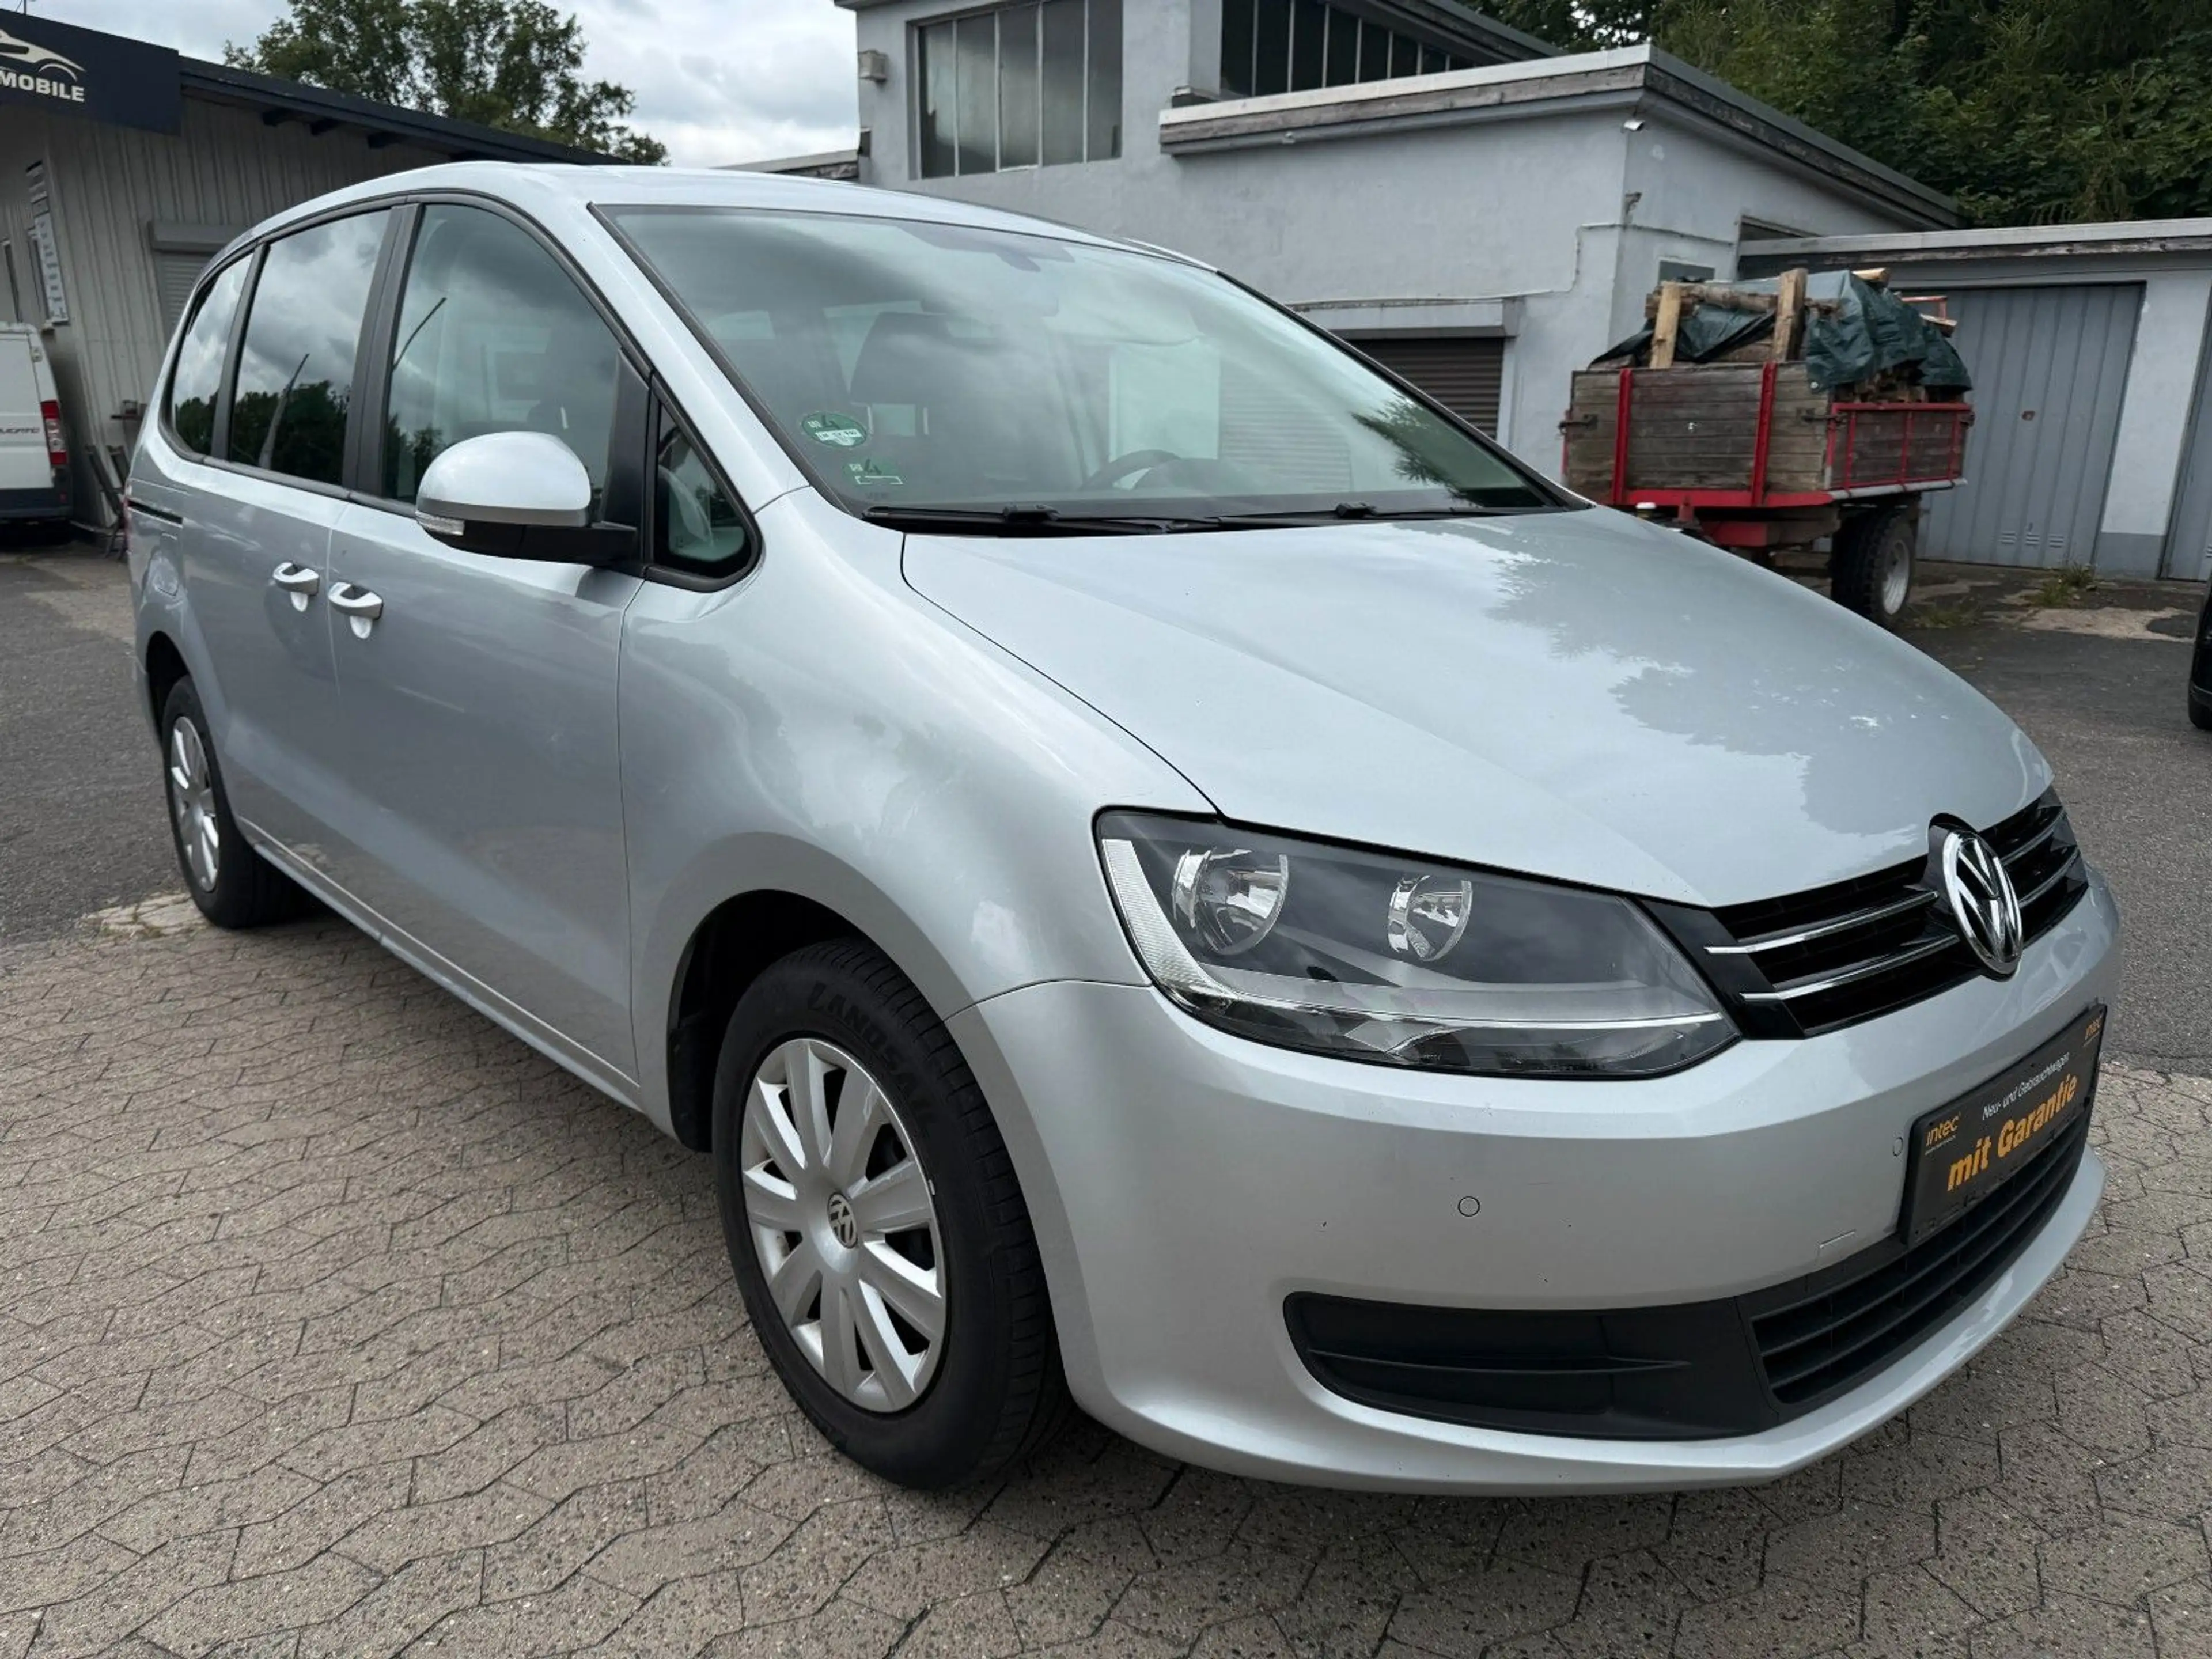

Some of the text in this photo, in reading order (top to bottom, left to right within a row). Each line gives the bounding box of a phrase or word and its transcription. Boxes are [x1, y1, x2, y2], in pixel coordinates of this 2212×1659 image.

[0, 70, 85, 103] MOBILE
[1926, 1115, 1959, 1147] intec
[1947, 1073, 2078, 1191] mit Garantie
